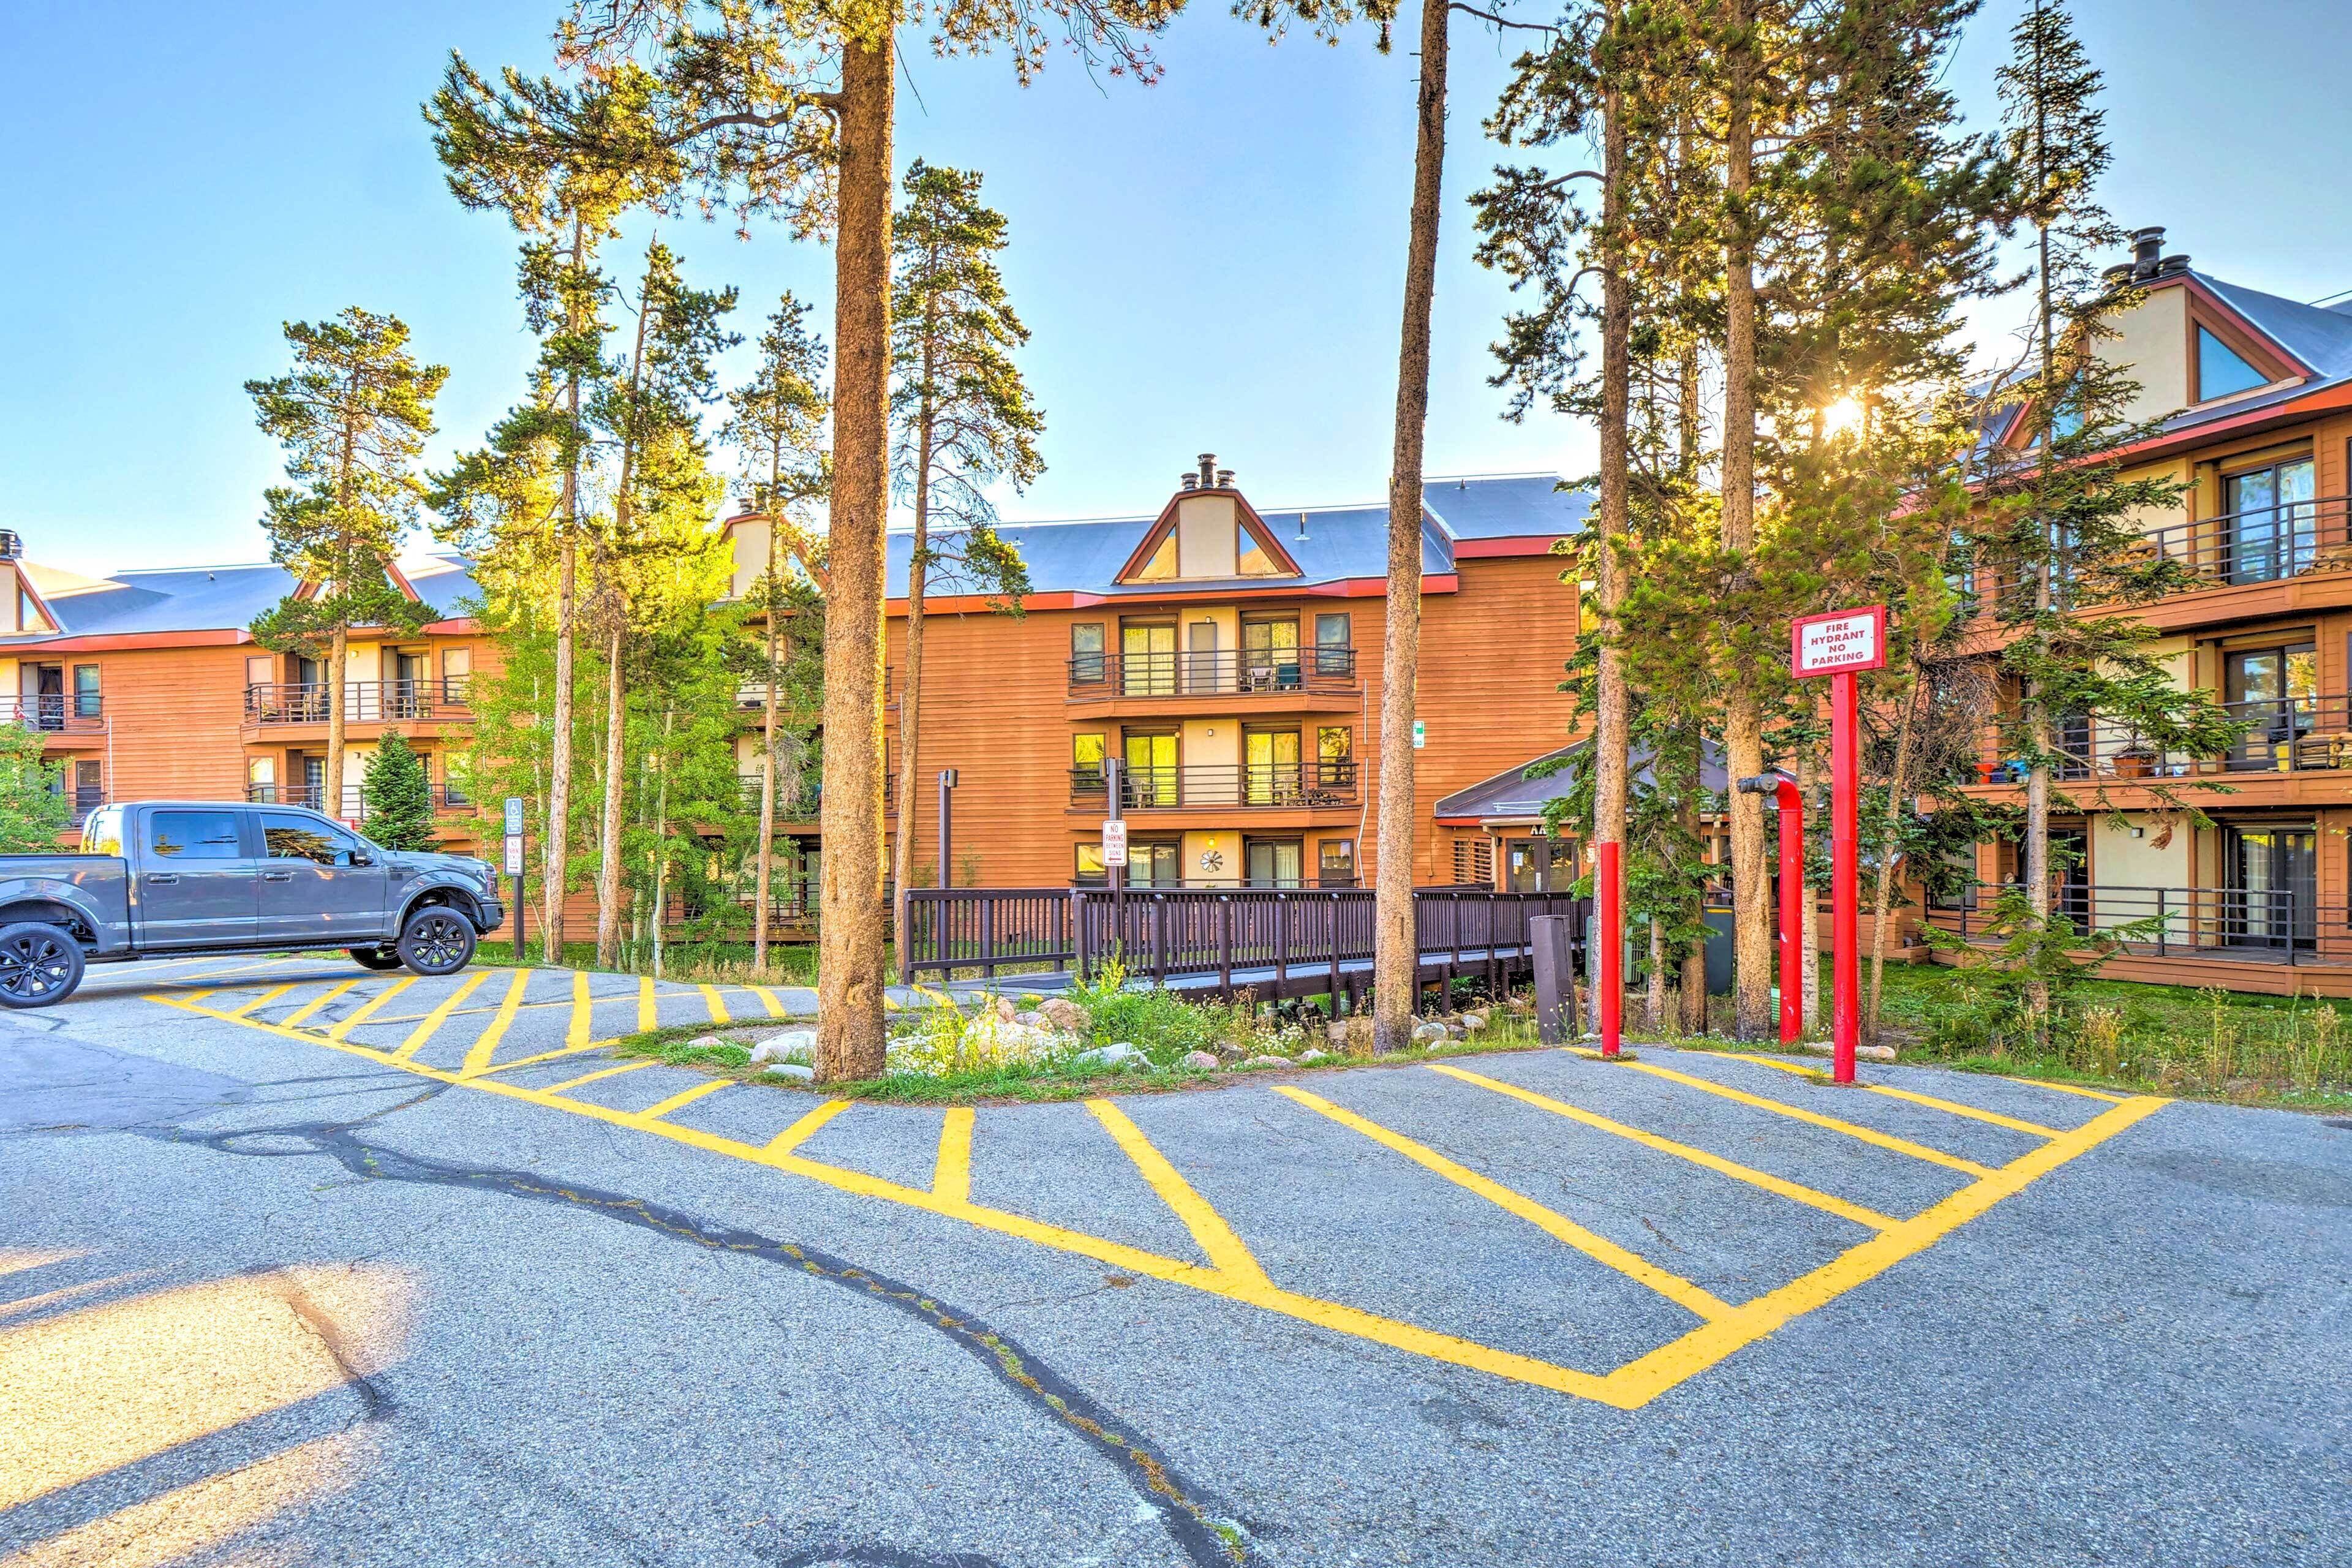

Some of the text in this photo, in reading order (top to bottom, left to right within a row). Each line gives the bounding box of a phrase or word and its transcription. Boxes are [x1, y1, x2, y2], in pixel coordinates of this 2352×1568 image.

[1826, 622, 1849, 633] FIRE
[1811, 630, 1865, 646] HYDRANT
[1829, 644, 1846, 653] NO
[1812, 652, 1864, 666] PARKING
